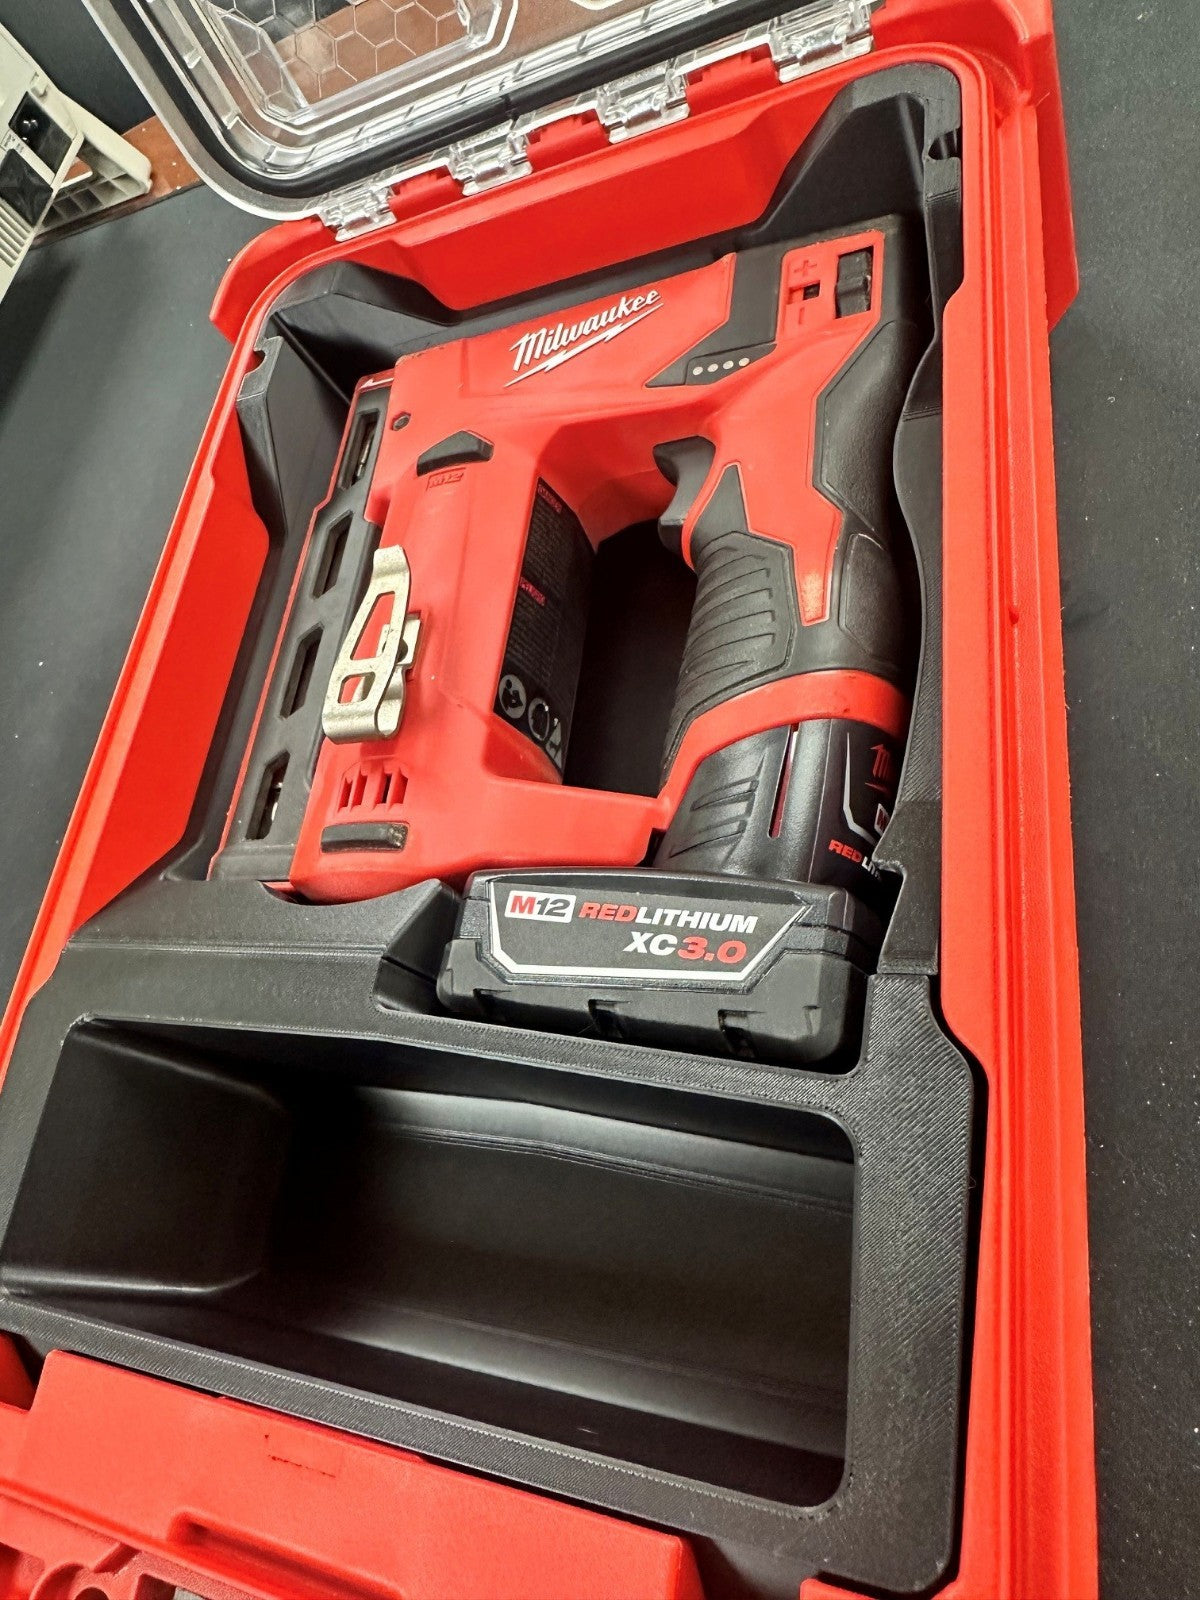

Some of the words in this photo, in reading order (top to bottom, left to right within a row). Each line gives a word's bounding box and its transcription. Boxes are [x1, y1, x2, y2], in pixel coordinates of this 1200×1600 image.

[509, 290, 661, 371] Milwaukee
[510, 895, 571, 917] M12
[579, 902, 758, 933] REDLITHIUM
